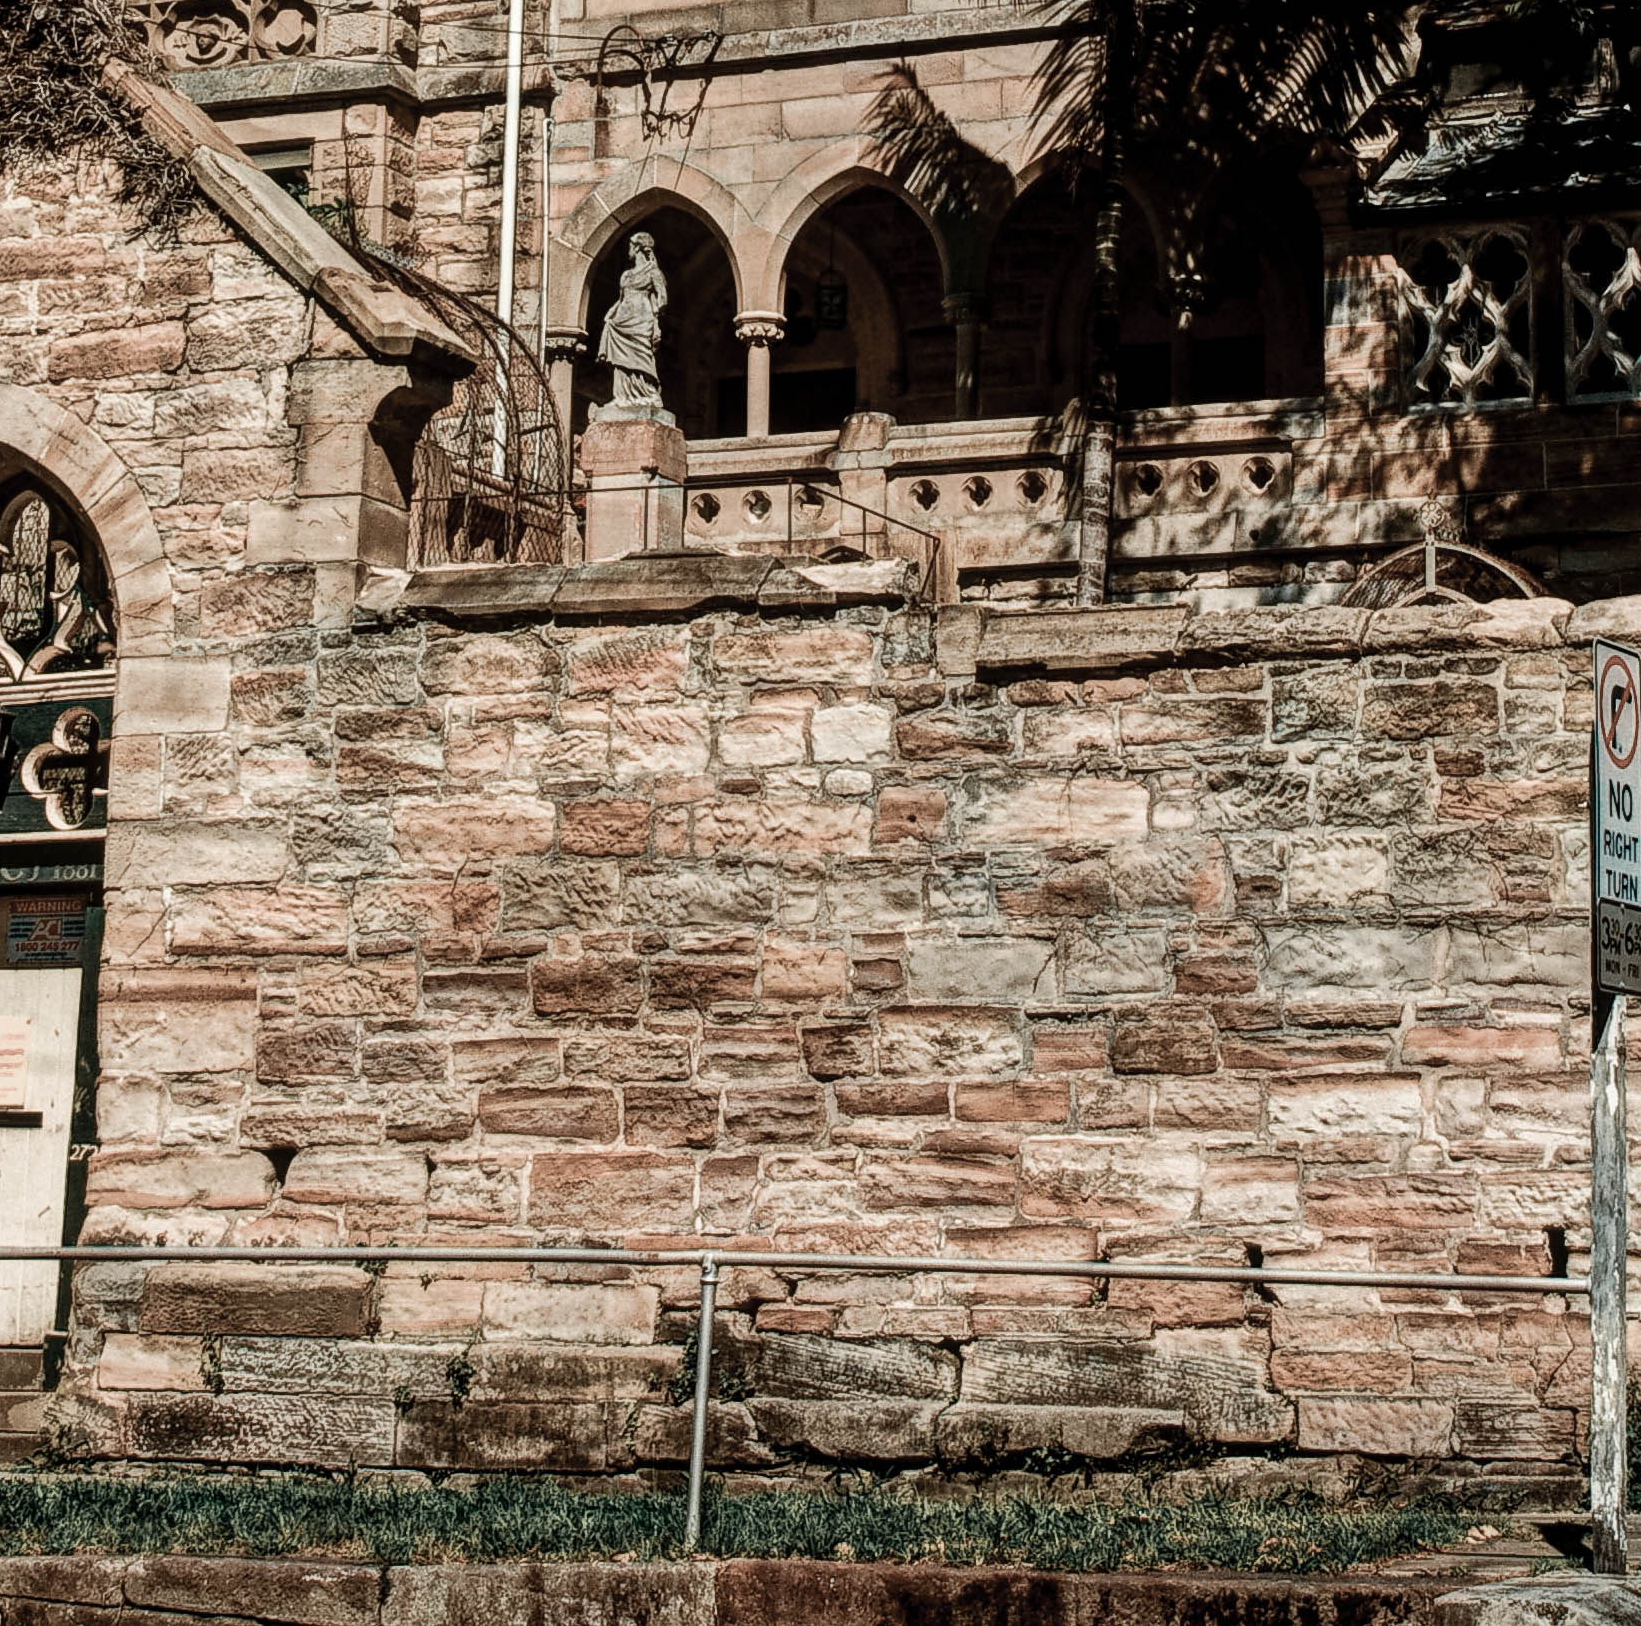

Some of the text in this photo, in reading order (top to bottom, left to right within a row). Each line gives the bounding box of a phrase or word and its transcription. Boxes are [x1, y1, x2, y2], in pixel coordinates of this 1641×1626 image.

[1609, 778, 1633, 822] NO
[1603, 828, 1639, 863] RIGHT
[1605, 868, 1638, 902] TURN
[16, 901, 82, 913] WARNING
[15, 942, 38, 952] 1800
[61, 941, 79, 951] 277
[1606, 958, 1620, 974] MON
[1628, 963, 1639, 979] FRI
